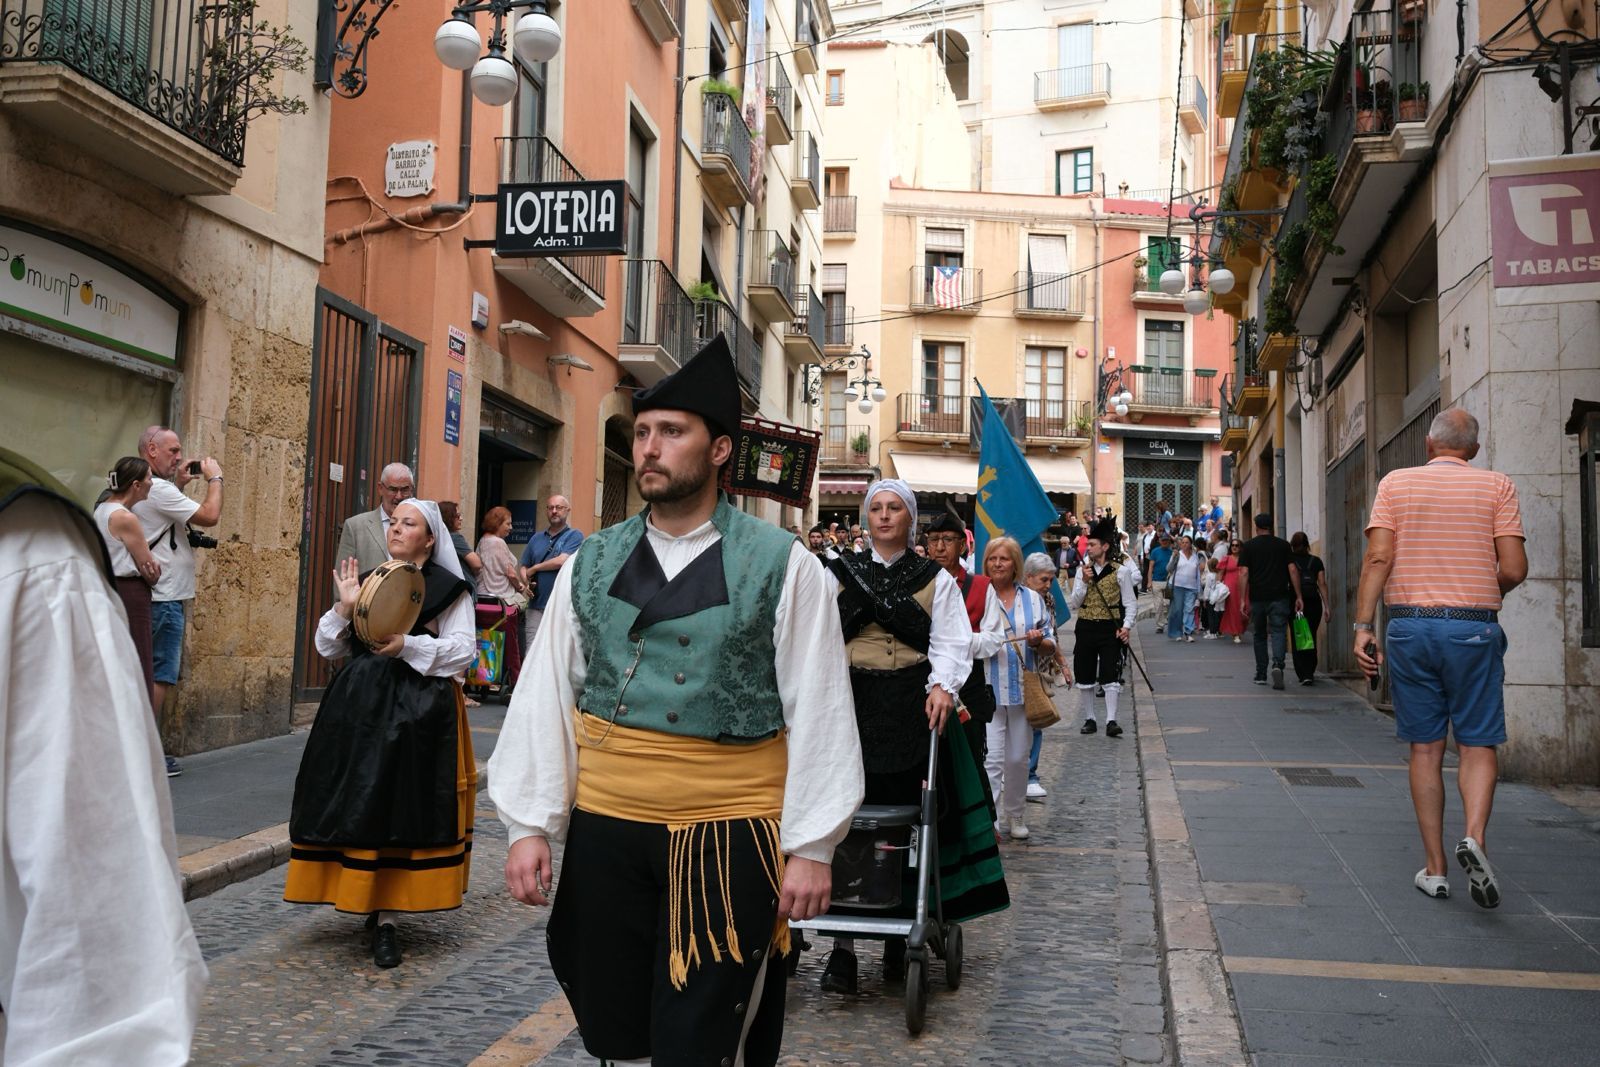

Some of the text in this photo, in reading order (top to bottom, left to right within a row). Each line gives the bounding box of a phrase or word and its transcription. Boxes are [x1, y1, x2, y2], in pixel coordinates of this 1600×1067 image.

[391, 149, 420, 160] DISTRITO
[395, 160, 417, 169] BARRIO
[400, 169, 420, 179] CALLE
[388, 179, 429, 190] DE LA PALMA
[505, 189, 616, 235] LOTERIA
[533, 235, 583, 247] Adm. 11
[1506, 255, 1600, 276] TABACS
[737, 435, 750, 481] CUDILLERO
[791, 447, 806, 491] ASTURIAS
